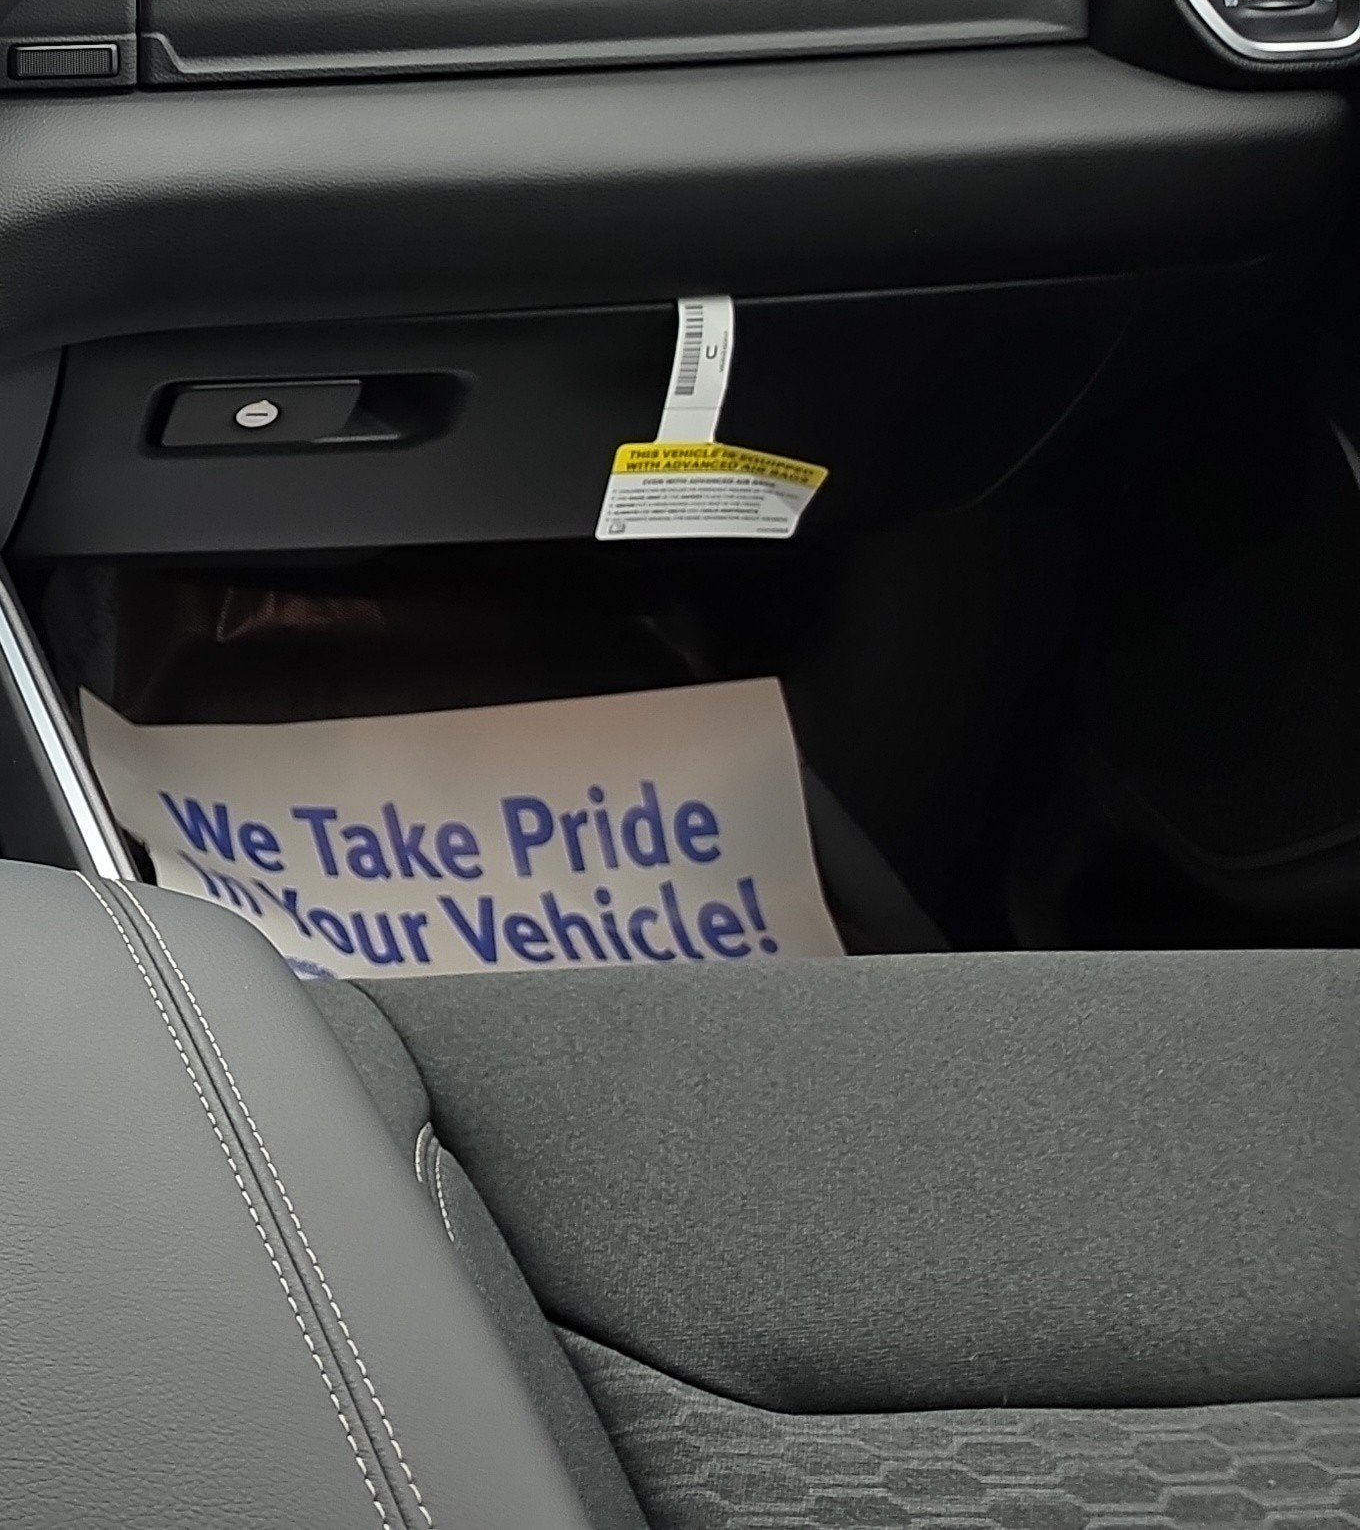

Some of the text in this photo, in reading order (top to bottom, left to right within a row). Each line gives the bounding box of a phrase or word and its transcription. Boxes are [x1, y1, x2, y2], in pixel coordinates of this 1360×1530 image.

[705, 345, 718, 360] U
[630, 449, 659, 460] THIS
[663, 447, 718, 459] VEHICLE
[626, 460, 661, 471] WITH
[663, 459, 738, 471] ADVANCED
[158, 779, 722, 881] We Take Pride
[262, 884, 432, 967] Your
[437, 874, 781, 966] Vehicle!
